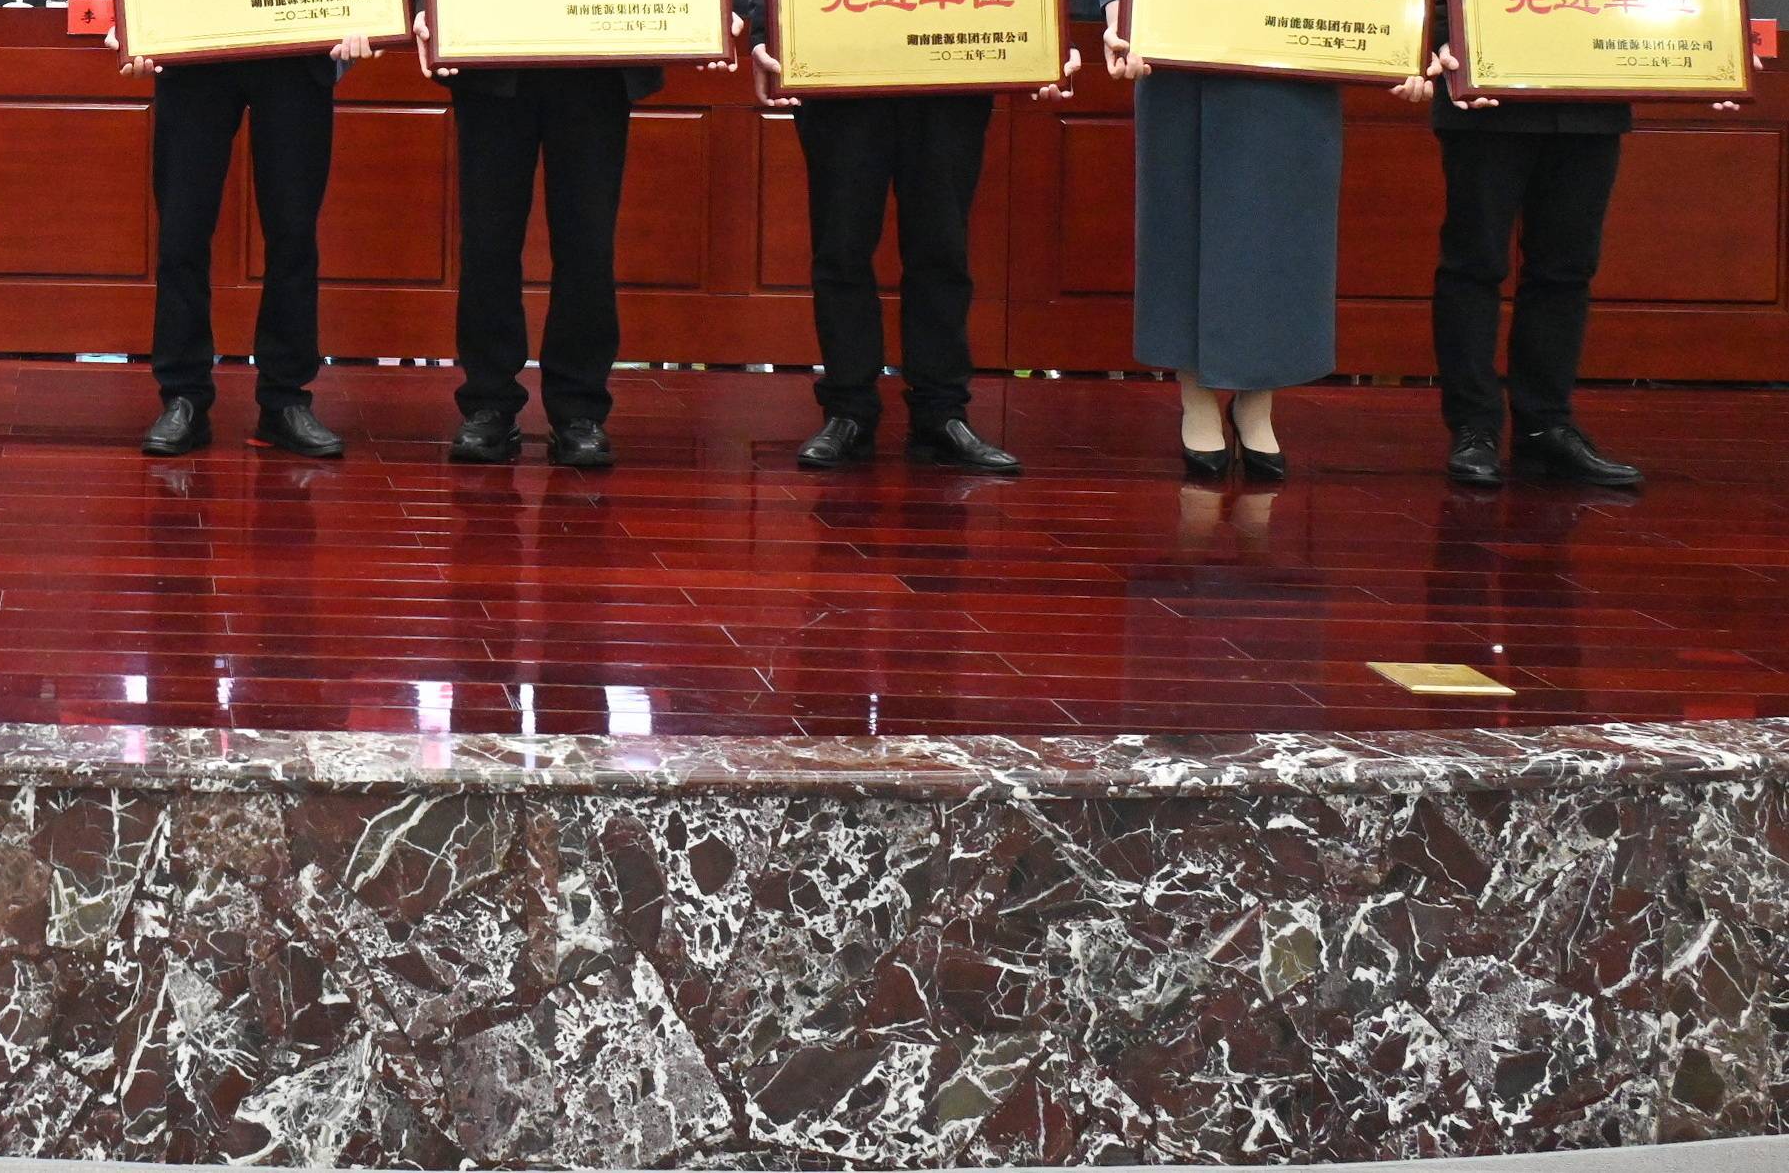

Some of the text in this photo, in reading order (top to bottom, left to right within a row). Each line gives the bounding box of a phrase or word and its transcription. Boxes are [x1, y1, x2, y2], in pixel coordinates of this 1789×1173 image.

[566, 2, 689, 17] 湖南能源集团有限公司
[1264, 15, 1391, 36] 湖南能源集团有限公司
[906, 31, 1029, 47] 湖南能源集团有限公司
[1592, 38, 1714, 52] 湖南能源集团有限公司
